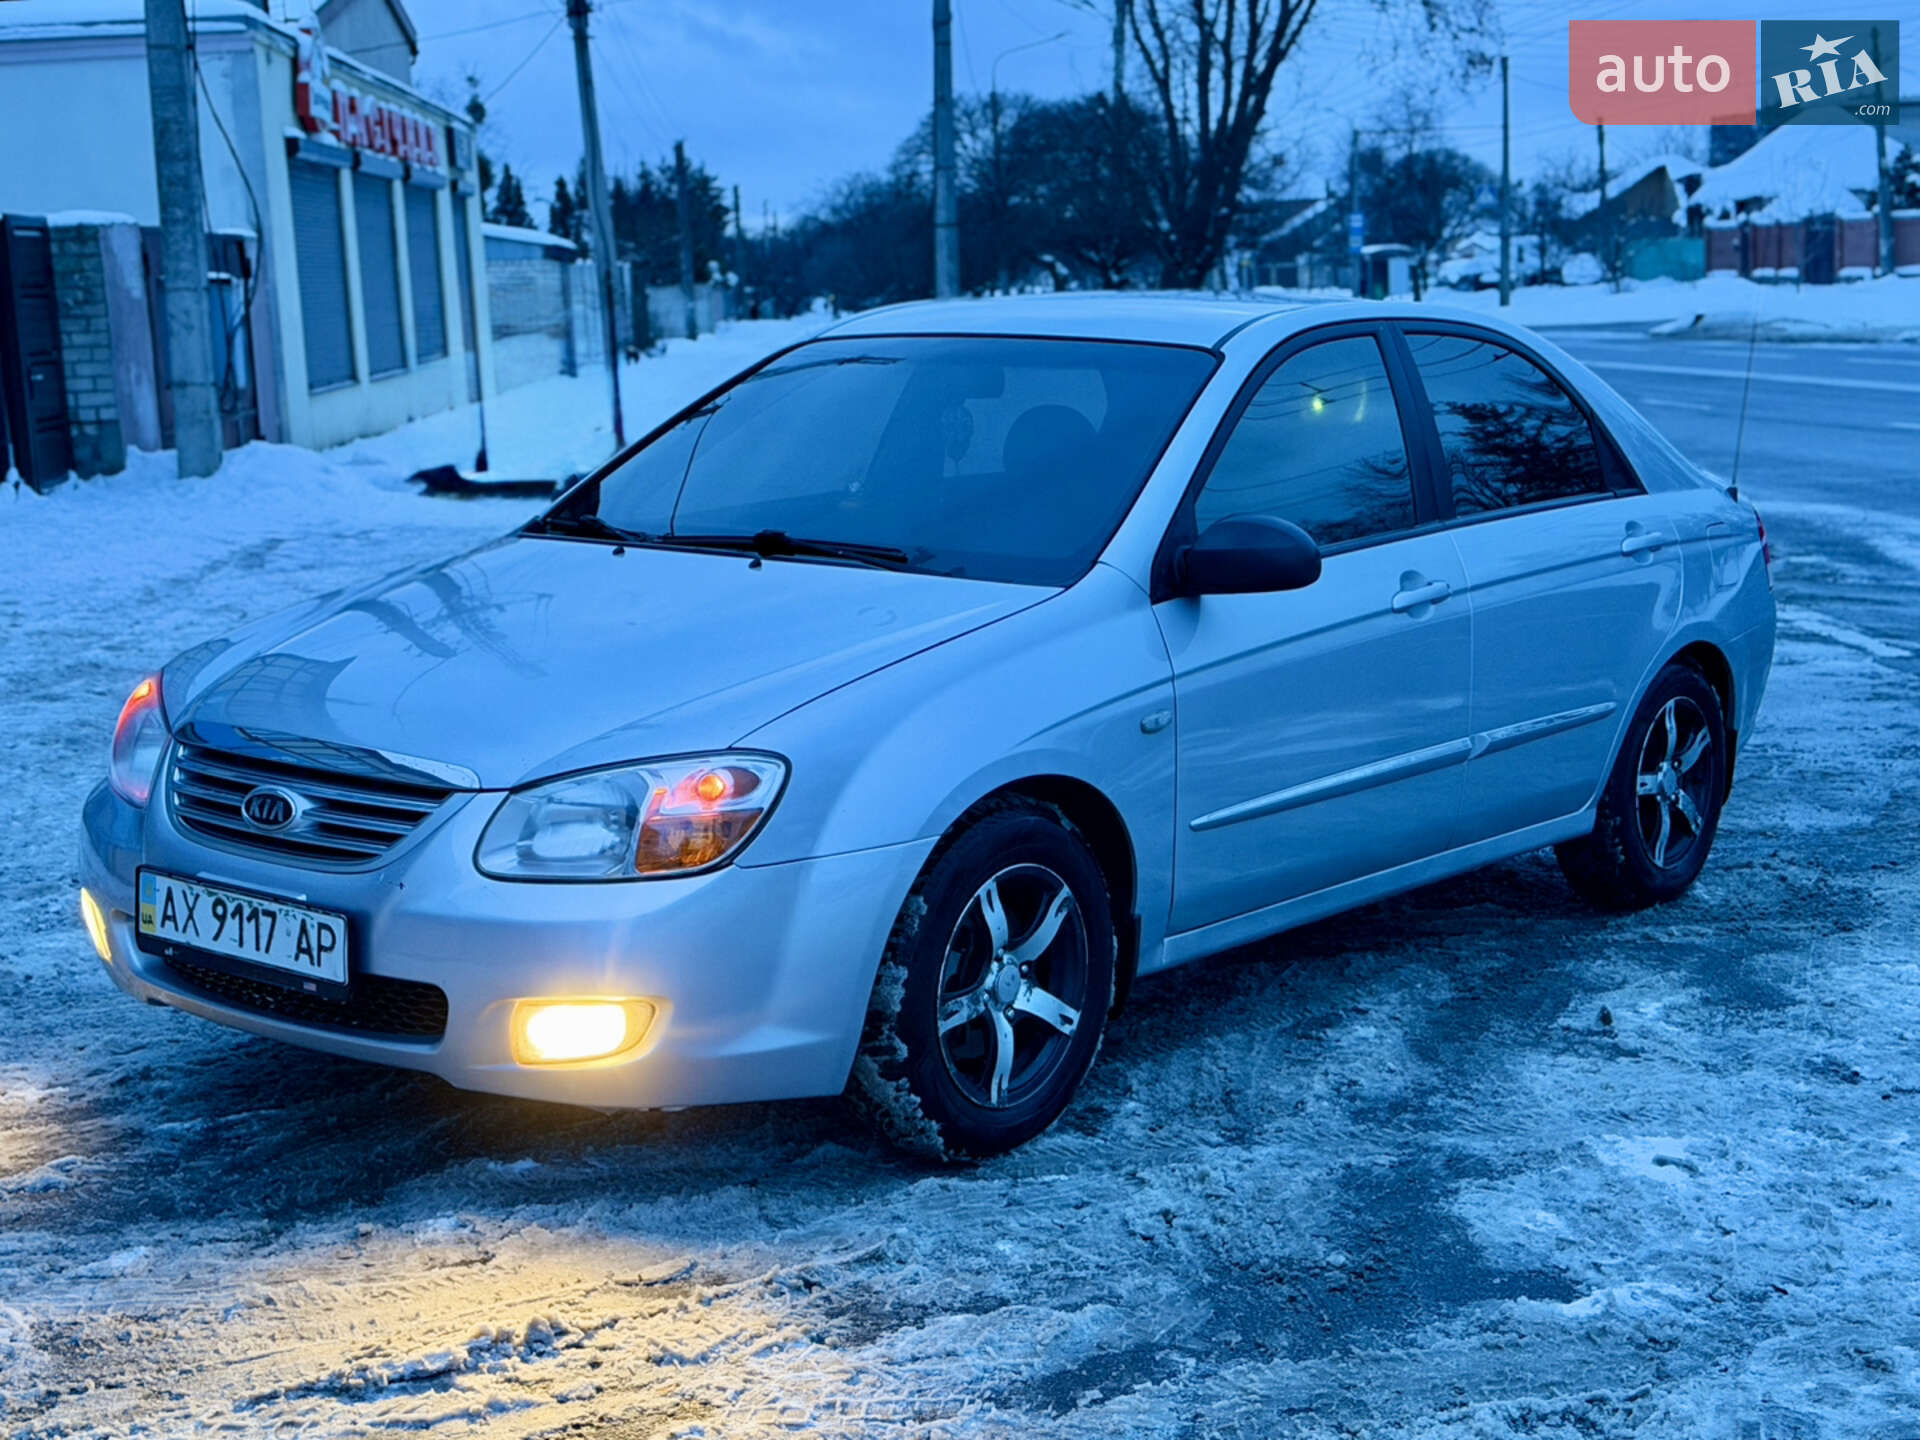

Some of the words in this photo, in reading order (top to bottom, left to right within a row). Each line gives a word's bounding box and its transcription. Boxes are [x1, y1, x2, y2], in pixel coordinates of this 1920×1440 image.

[250, 797, 284, 822] KIA
[141, 913, 154, 926] UA
[160, 886, 201, 938] AX
[211, 897, 278, 955] 9117
[294, 918, 337, 968] AP
